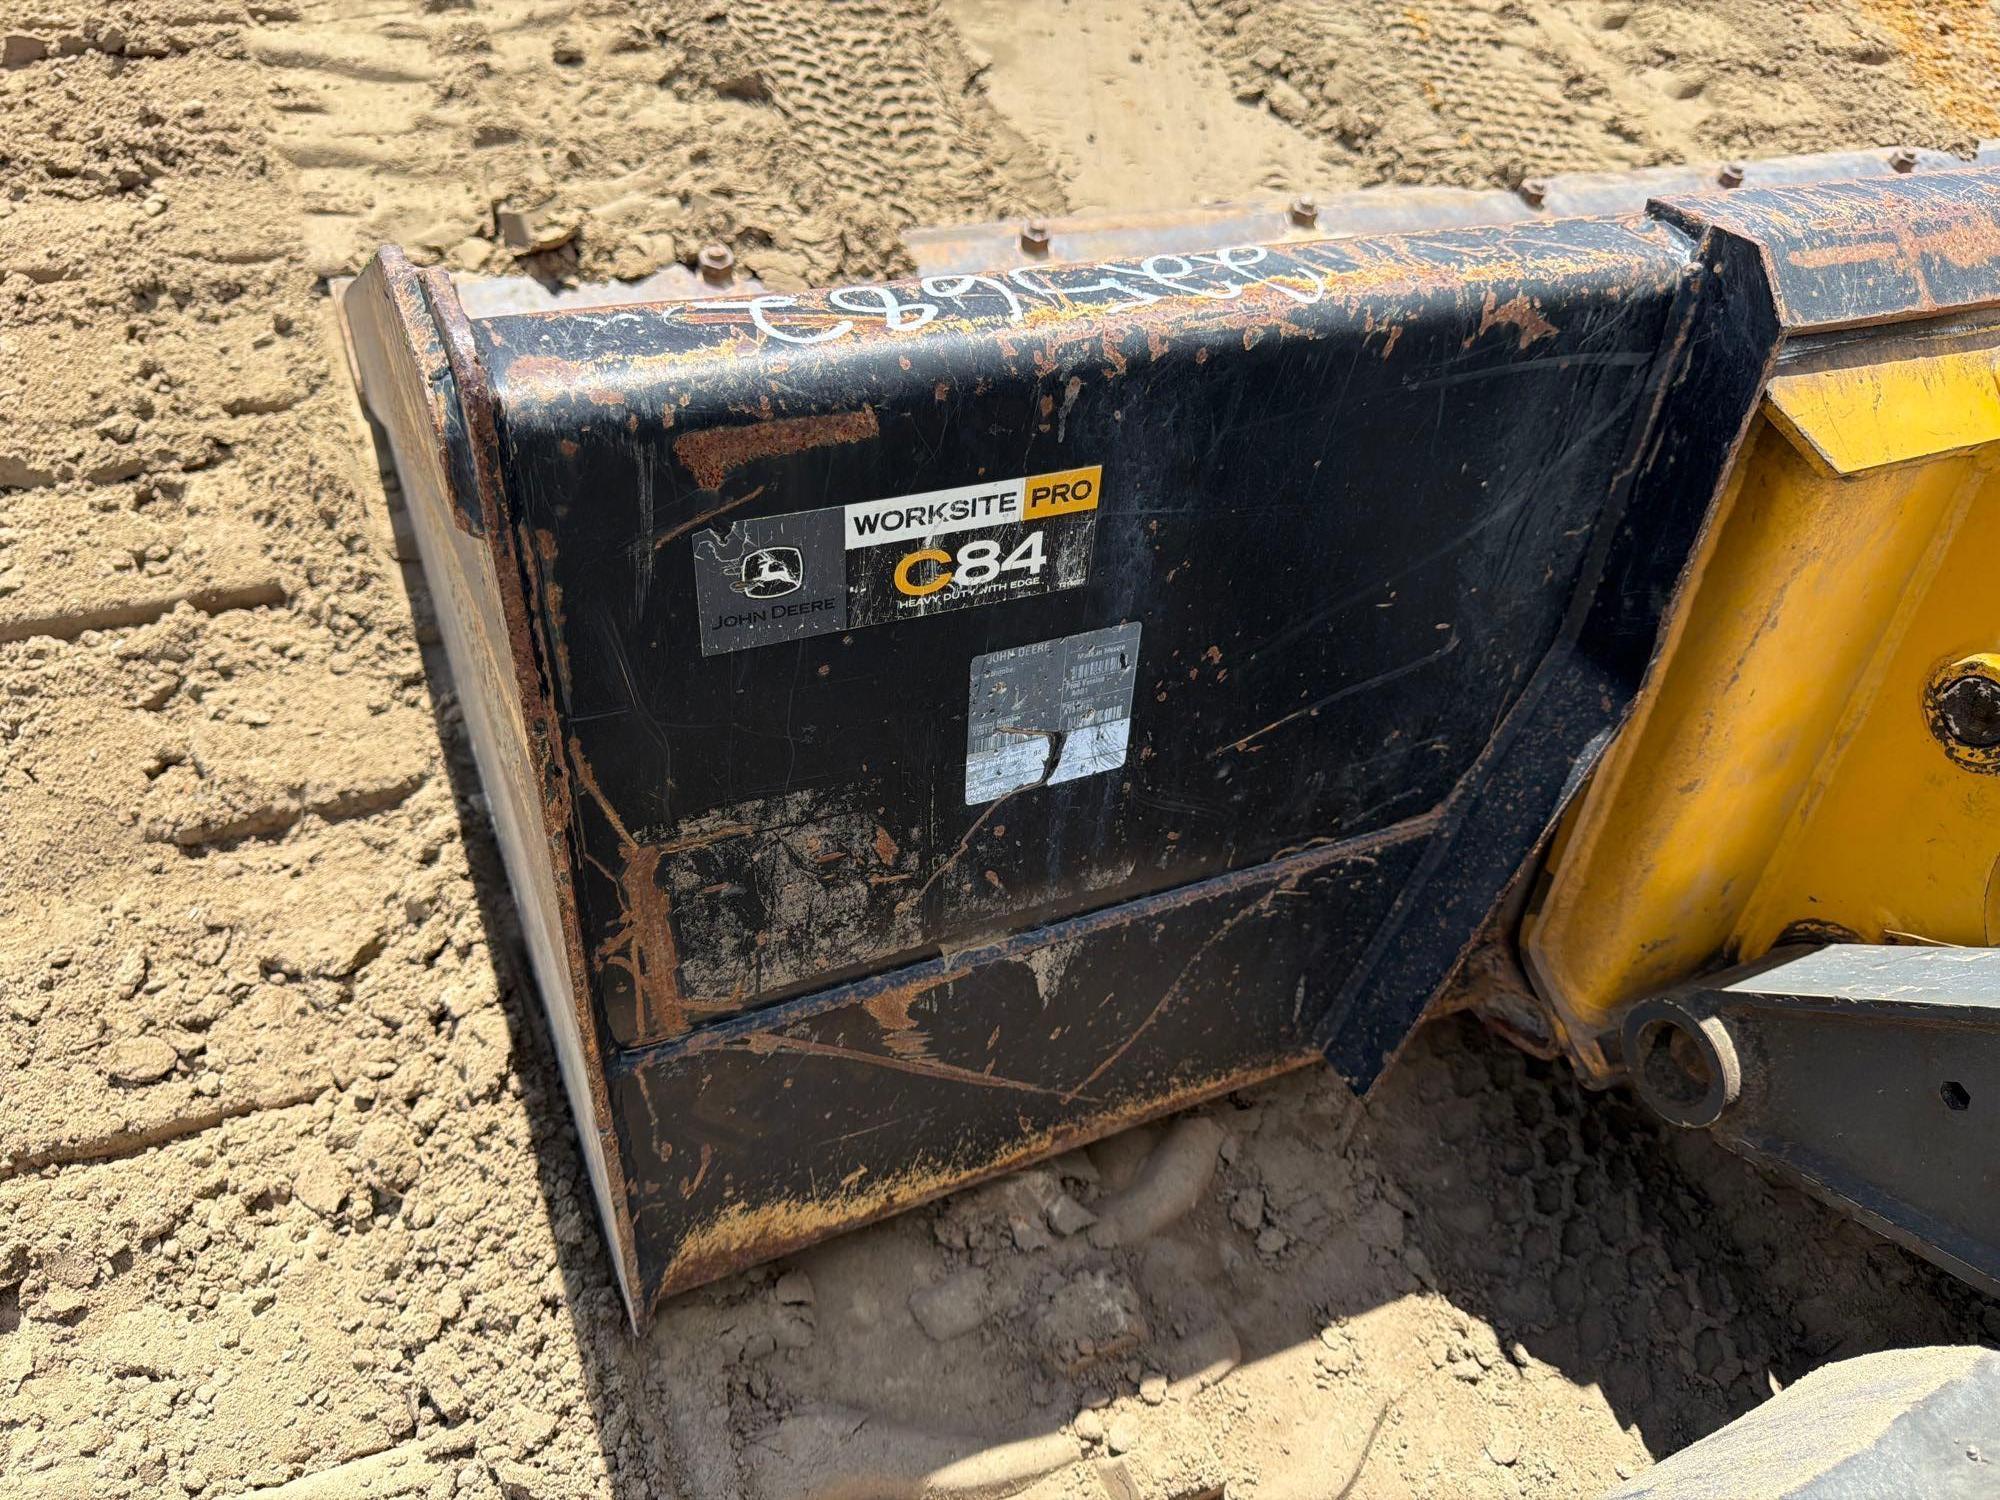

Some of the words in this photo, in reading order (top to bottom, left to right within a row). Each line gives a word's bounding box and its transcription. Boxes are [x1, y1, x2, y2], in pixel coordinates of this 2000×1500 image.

[853, 491, 1018, 536] WORKSITE
[1031, 479, 1093, 508] PRO
[894, 531, 1047, 596] C84
[899, 595, 941, 609] HEAVY
[943, 588, 977, 602] DUTY
[1010, 576, 1041, 590] EDGE
[712, 610, 767, 631] JOHN
[771, 598, 836, 620] DEERE
[987, 651, 1015, 665] JOHN
[1018, 643, 1051, 658] DEERE
